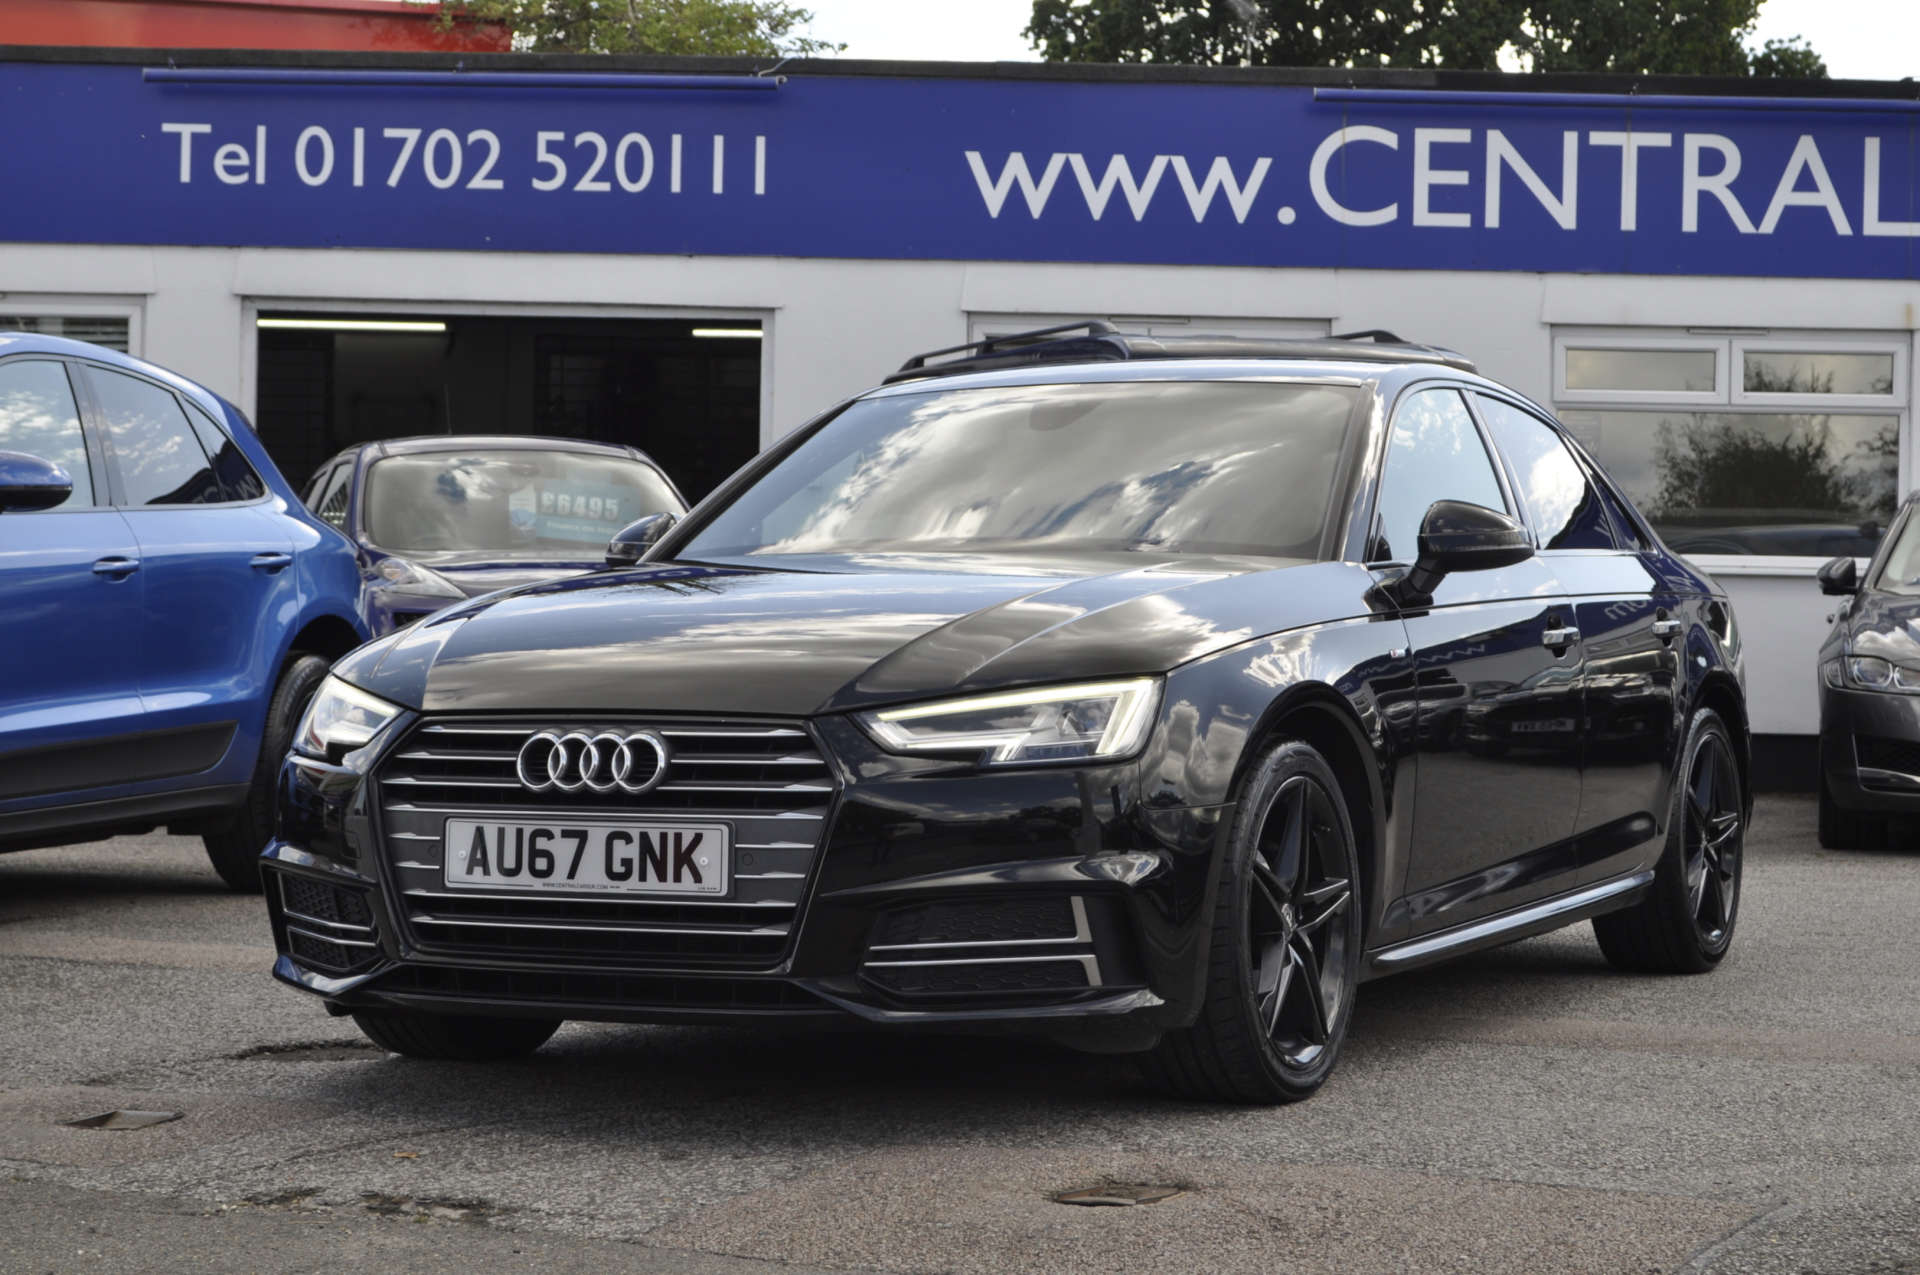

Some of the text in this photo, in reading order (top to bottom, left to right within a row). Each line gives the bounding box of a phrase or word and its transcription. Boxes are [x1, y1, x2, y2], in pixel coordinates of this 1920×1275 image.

[162, 123, 766, 196] Tel 01702 520111
[964, 125, 1920, 237] www.CENTRAL
[541, 490, 620, 521] £6495
[465, 825, 704, 885] AU67 GNK
